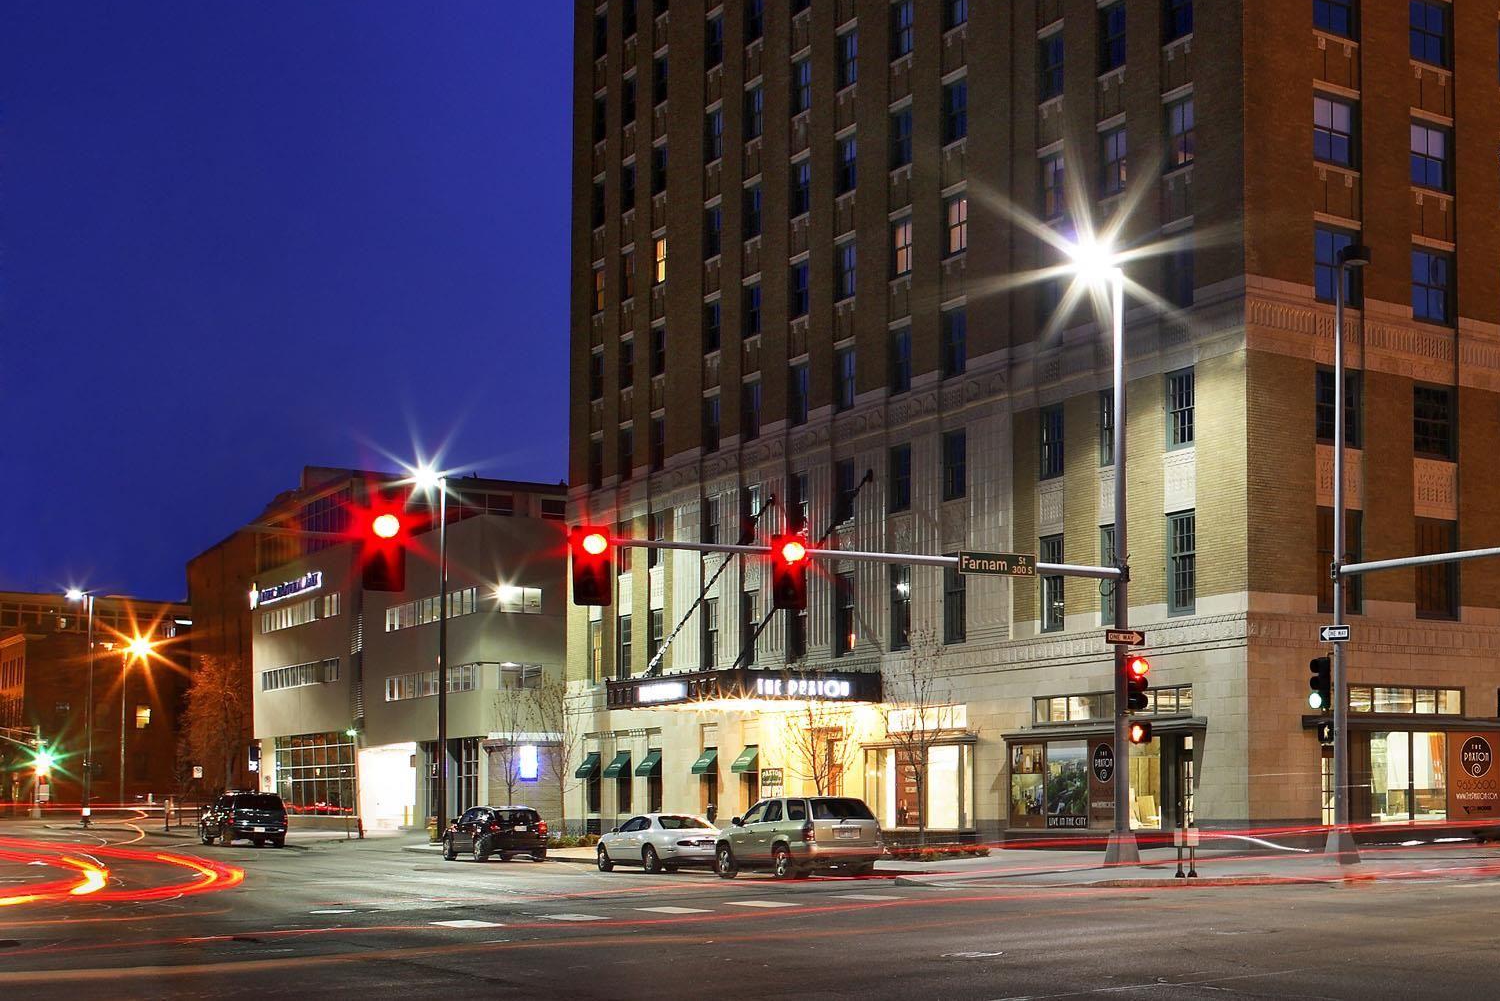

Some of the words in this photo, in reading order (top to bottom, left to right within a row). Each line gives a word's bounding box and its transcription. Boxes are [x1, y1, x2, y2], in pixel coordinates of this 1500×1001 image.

[962, 555, 1007, 571] Farnam
[1018, 556, 1026, 565] St
[1012, 565, 1026, 574] 300
[1028, 566, 1033, 574] S
[757, 678, 781, 695] THE
[788, 679, 850, 697] PAXTON
[1464, 752, 1489, 761] PAXTON
[1048, 818, 1058, 826] LIVE
[1075, 817, 1086, 826] CITY
